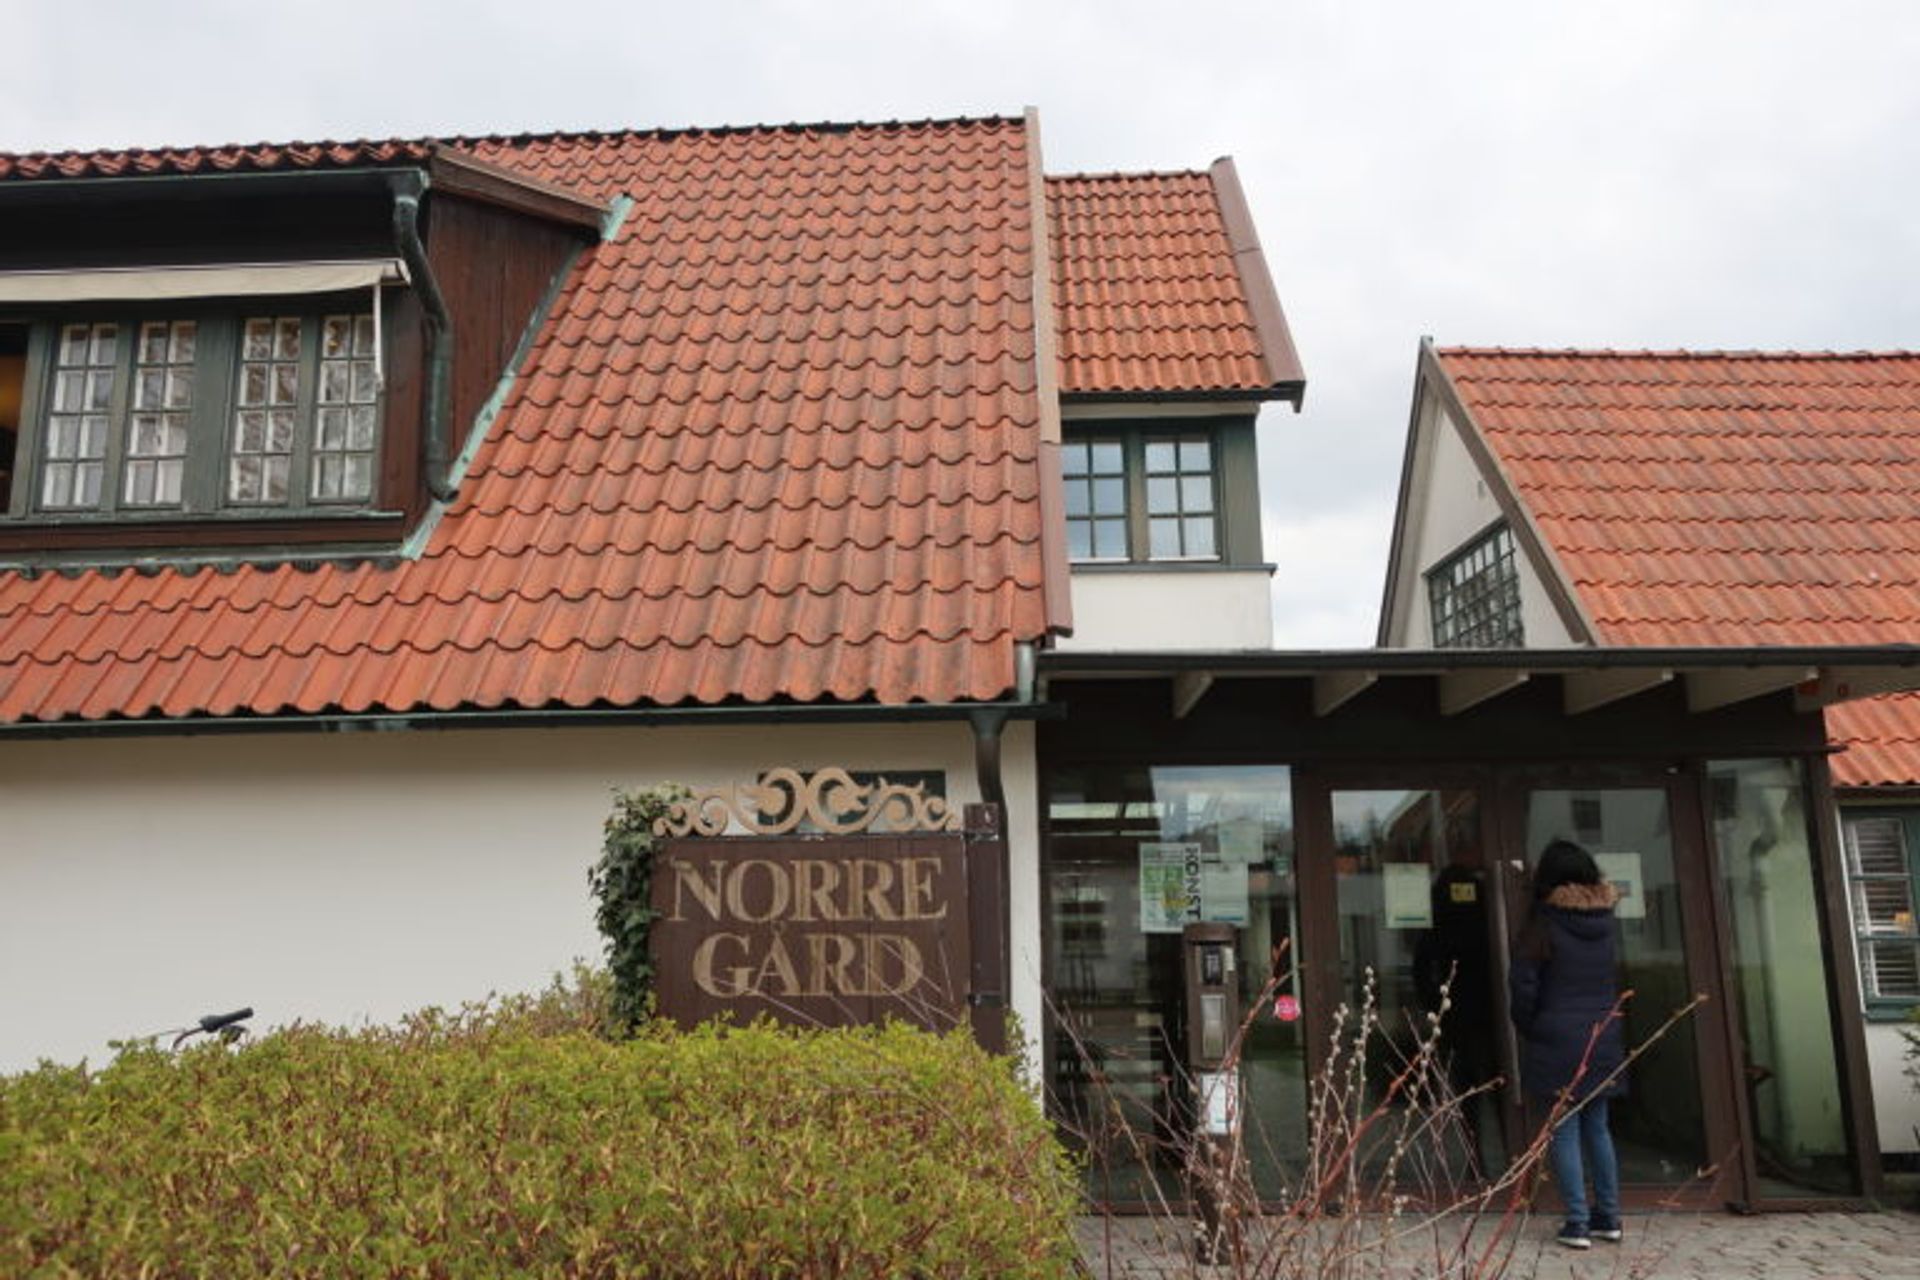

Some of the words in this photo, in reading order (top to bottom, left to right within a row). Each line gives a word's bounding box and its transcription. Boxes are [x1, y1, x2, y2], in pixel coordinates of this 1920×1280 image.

[668, 857, 948, 922] NORRE
[1185, 847, 1201, 920] KONST
[692, 920, 925, 998] GÅRD
